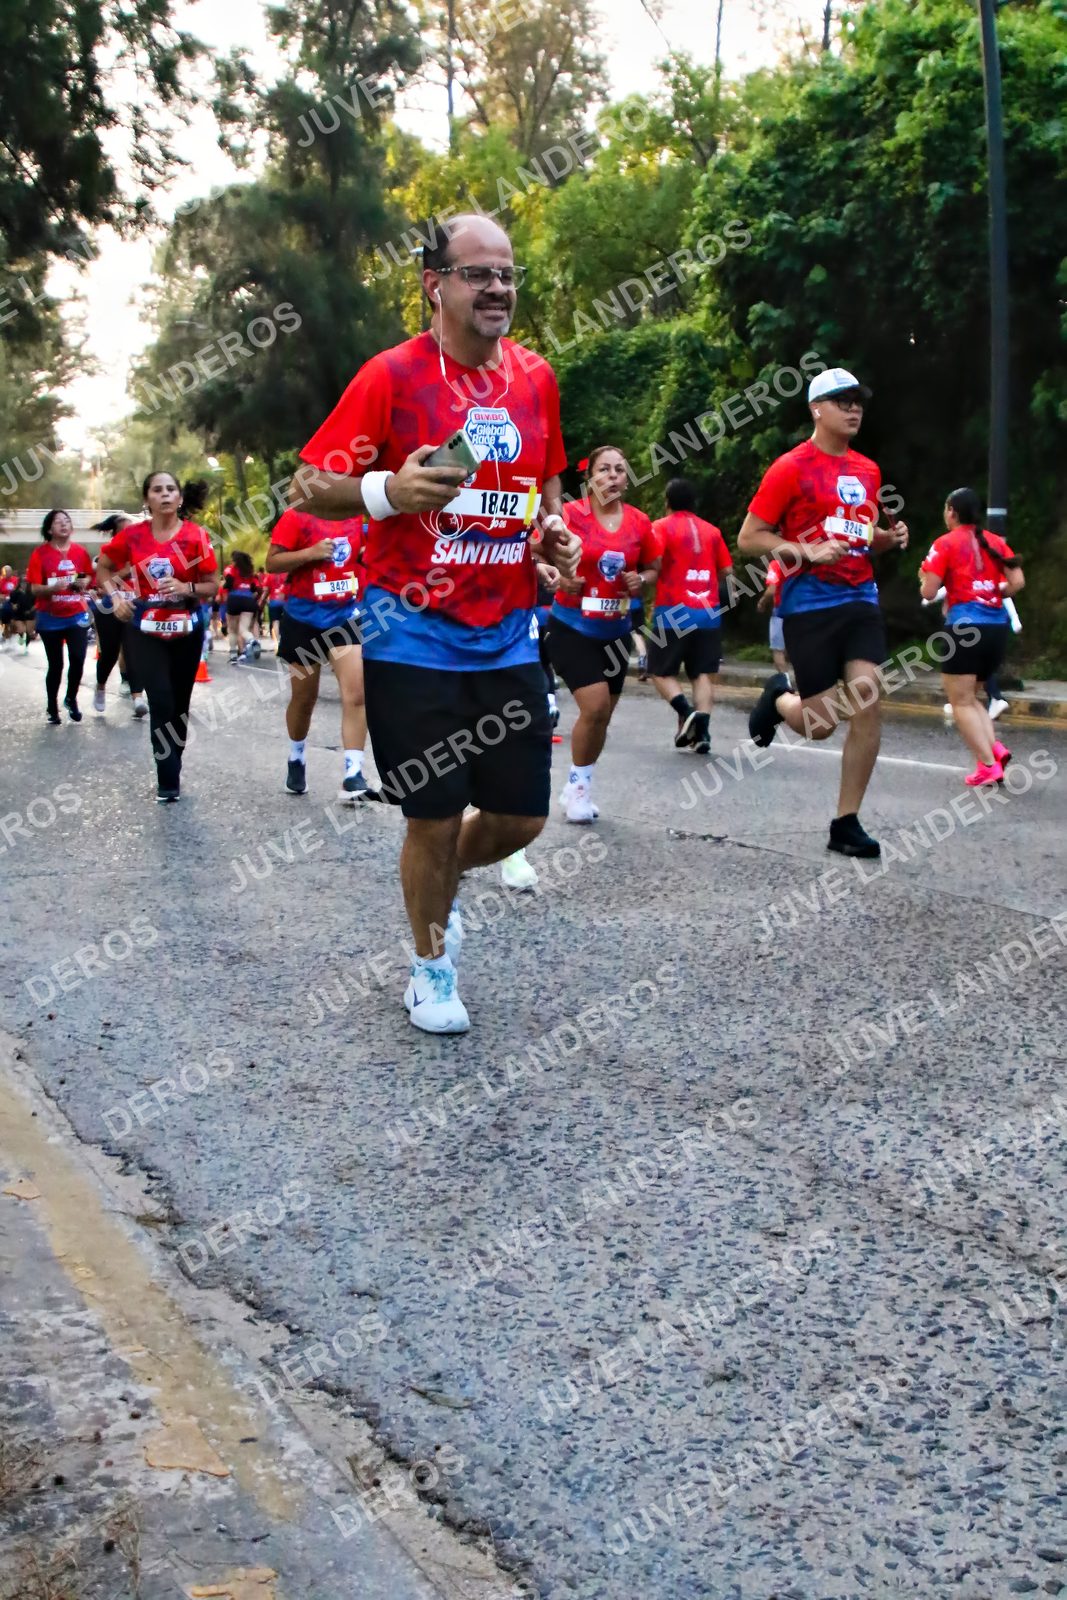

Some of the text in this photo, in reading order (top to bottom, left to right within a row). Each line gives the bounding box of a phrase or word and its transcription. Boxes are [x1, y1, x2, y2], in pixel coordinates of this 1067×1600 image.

[474, 413, 505, 421] BIMBO
[476, 424, 506, 435] Global
[480, 491, 519, 516] 1842
[431, 538, 526, 565] SANTIAGO
[330, 580, 349, 592] 3421
[600, 599, 621, 610] 1222
